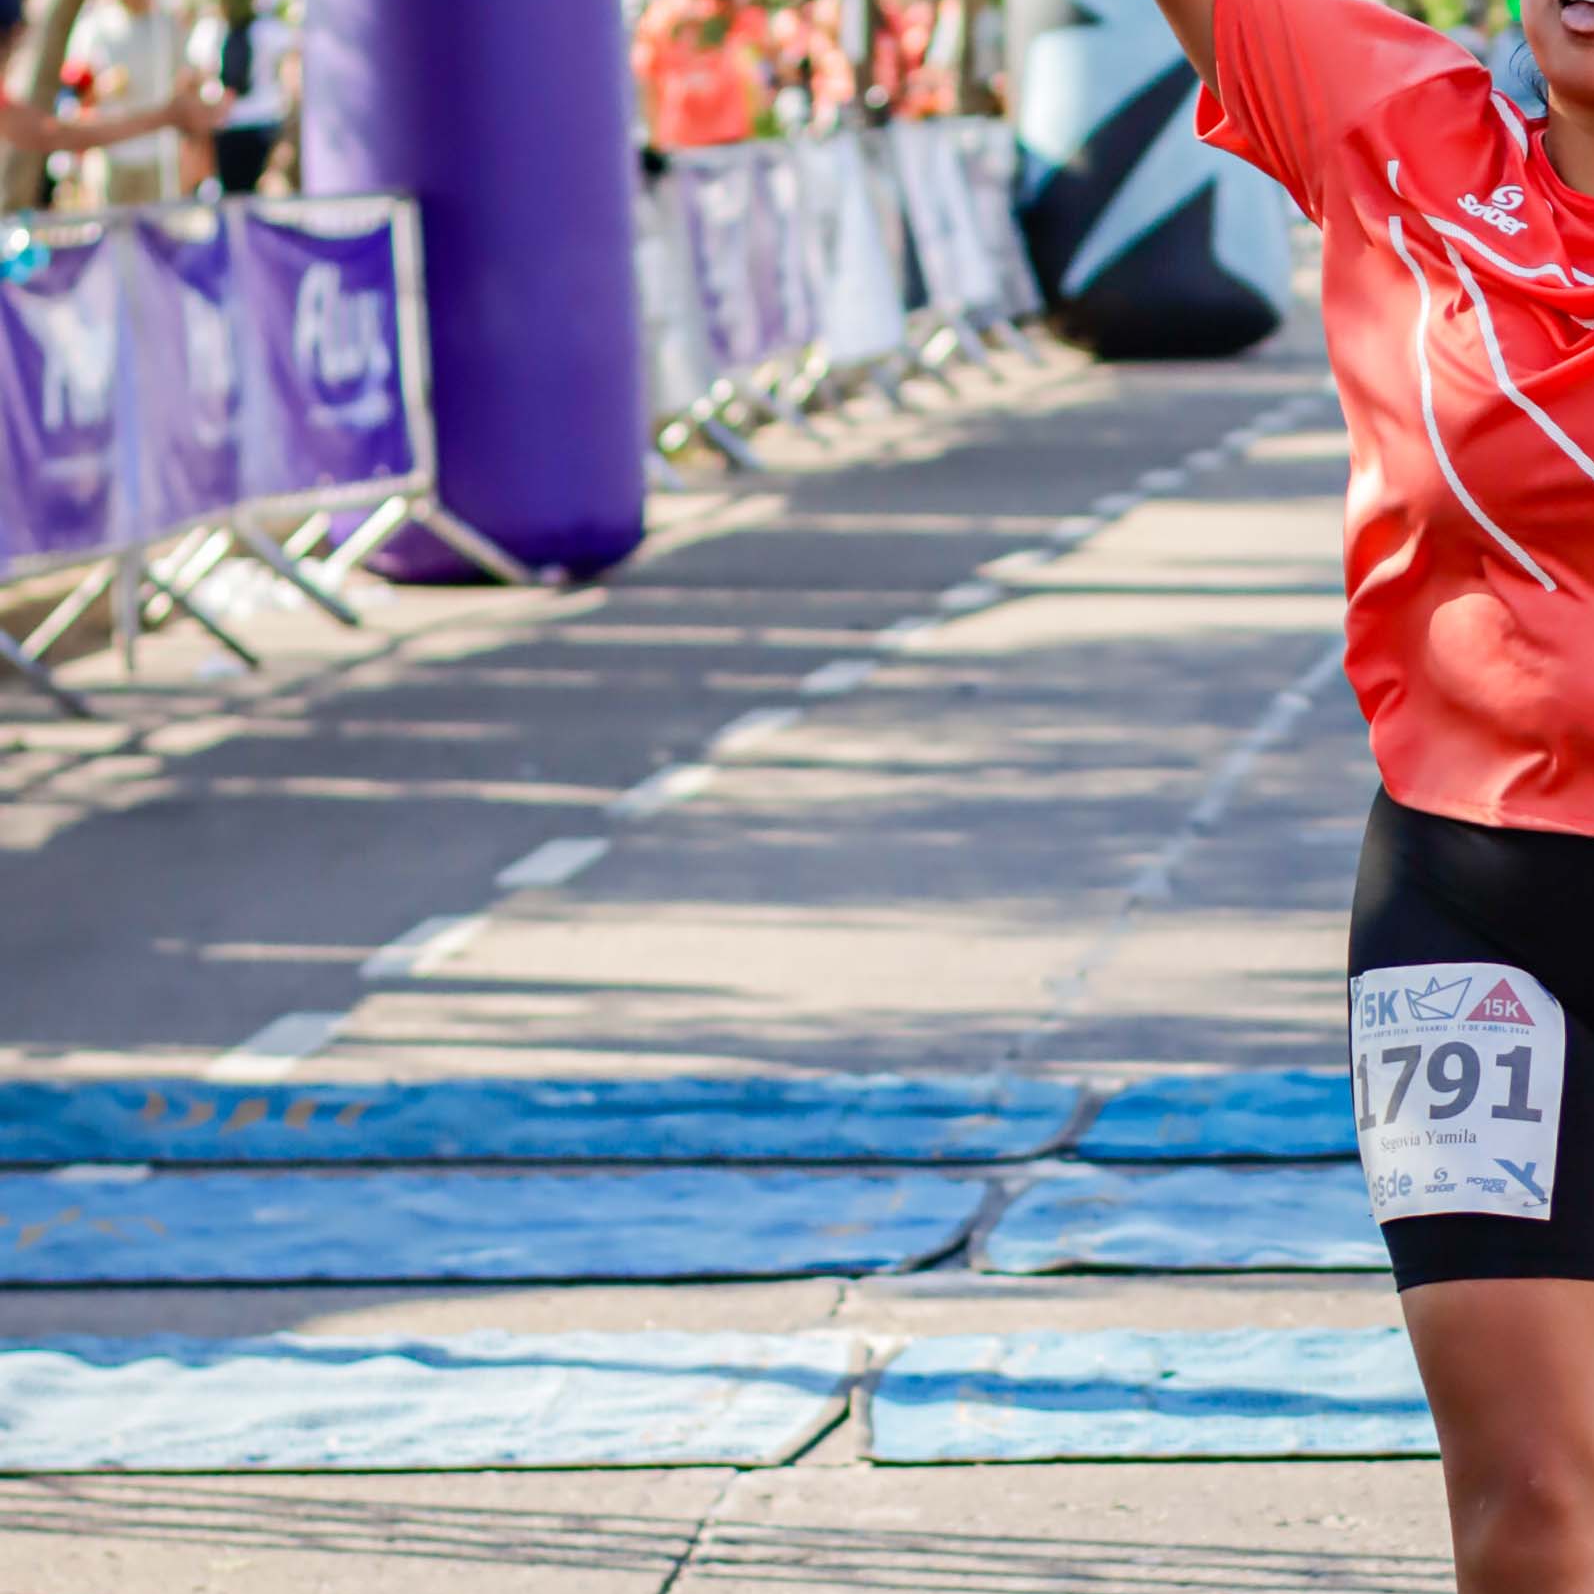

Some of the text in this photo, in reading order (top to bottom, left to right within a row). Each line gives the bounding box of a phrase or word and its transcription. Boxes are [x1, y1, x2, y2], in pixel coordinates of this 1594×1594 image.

[1482, 997, 1521, 1018] 15K
[1356, 1040, 1543, 1132] 1791
[1425, 1130, 1477, 1145] Yamila
